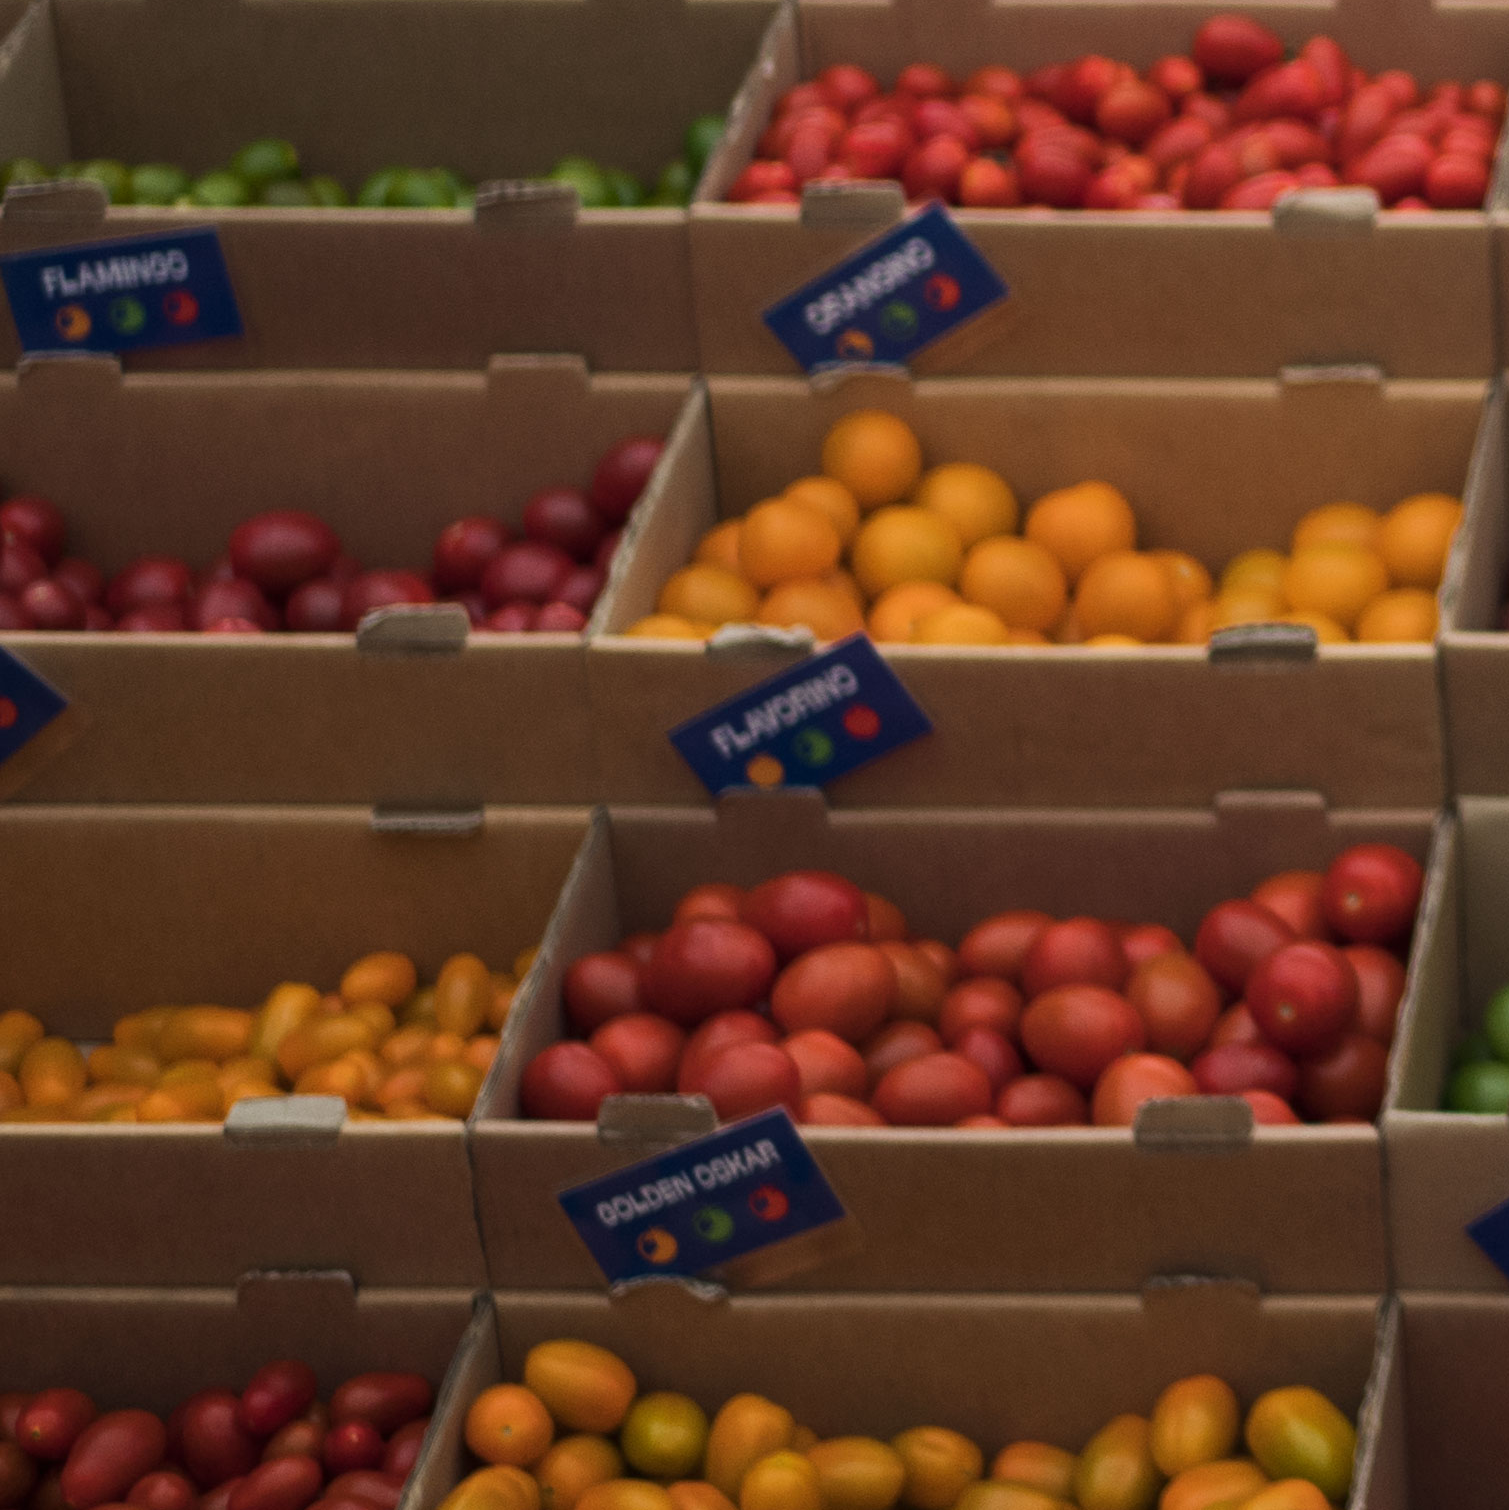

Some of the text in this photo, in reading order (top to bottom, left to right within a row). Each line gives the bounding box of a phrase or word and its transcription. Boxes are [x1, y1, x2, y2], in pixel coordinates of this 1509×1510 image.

[42, 250, 188, 295] FLAMINGO
[711, 664, 858, 756] FLAVORINO
[597, 1140, 779, 1226] GOLDEN OSKAR
